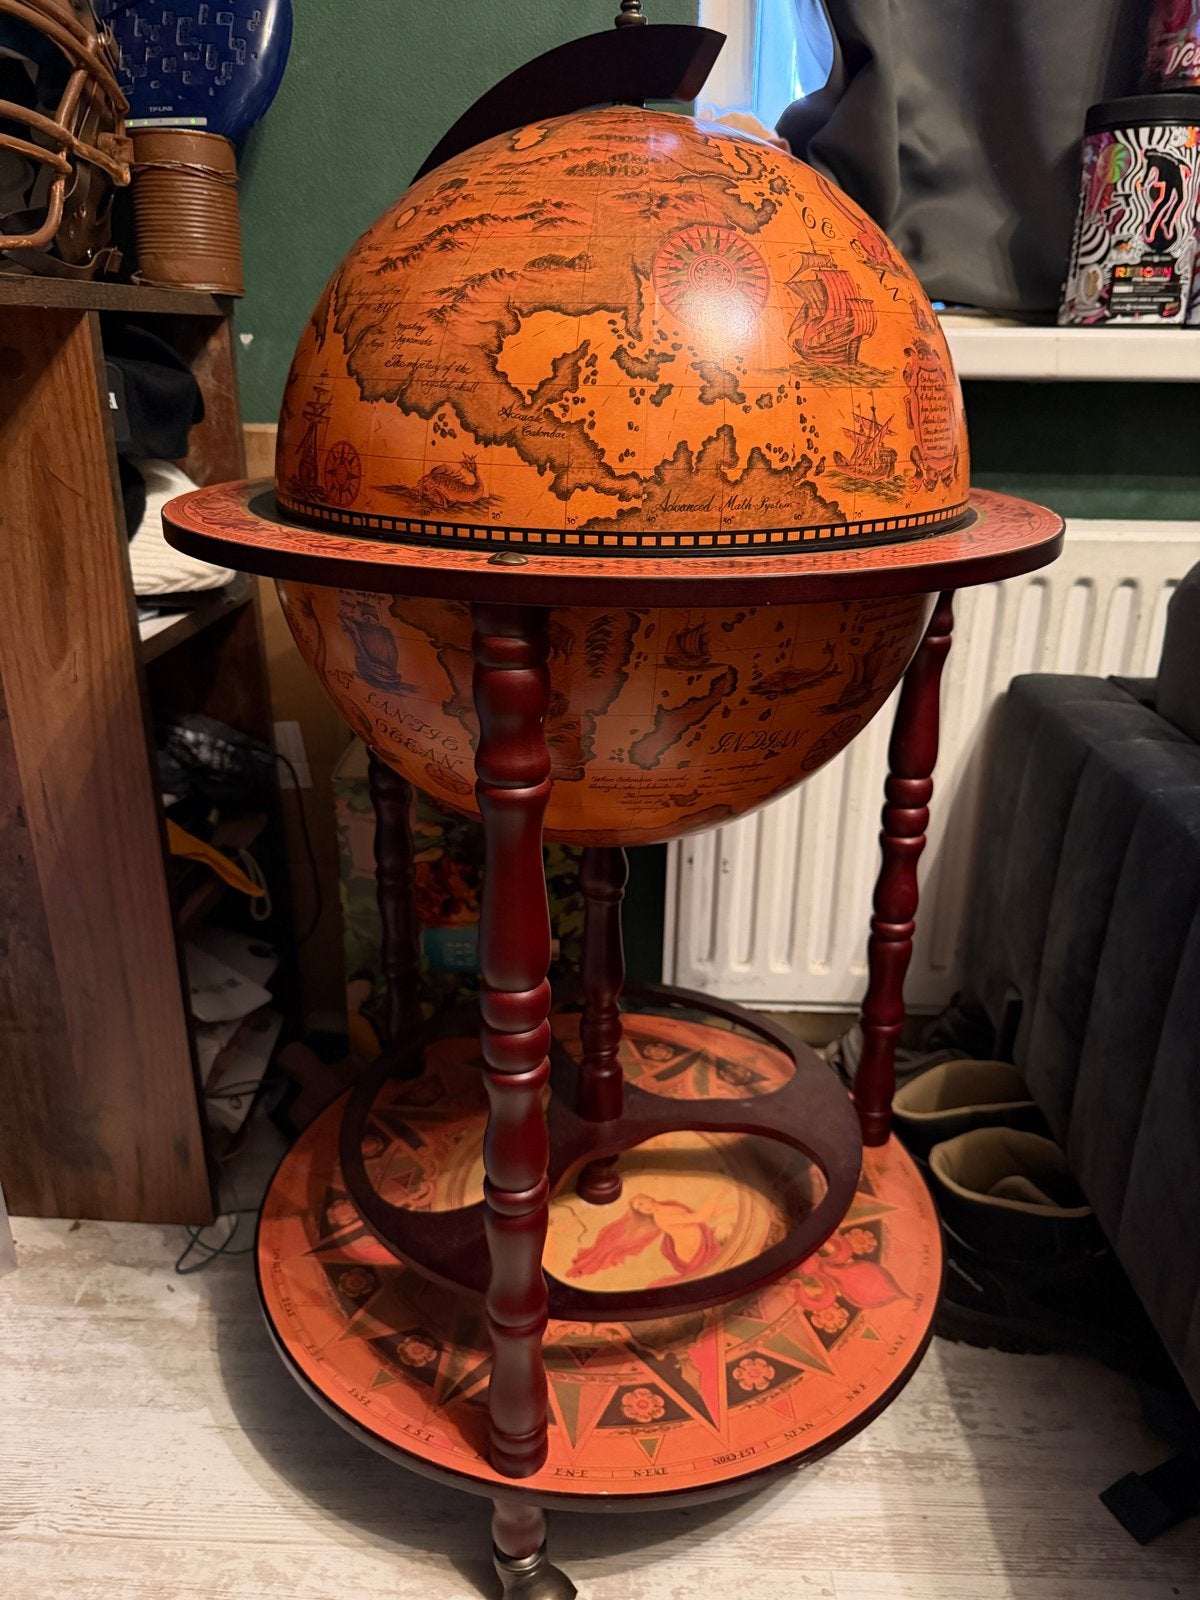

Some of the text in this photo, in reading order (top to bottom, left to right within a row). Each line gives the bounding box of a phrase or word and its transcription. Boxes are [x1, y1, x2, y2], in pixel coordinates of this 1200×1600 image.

[651, 489, 792, 516] Advanced Math System
